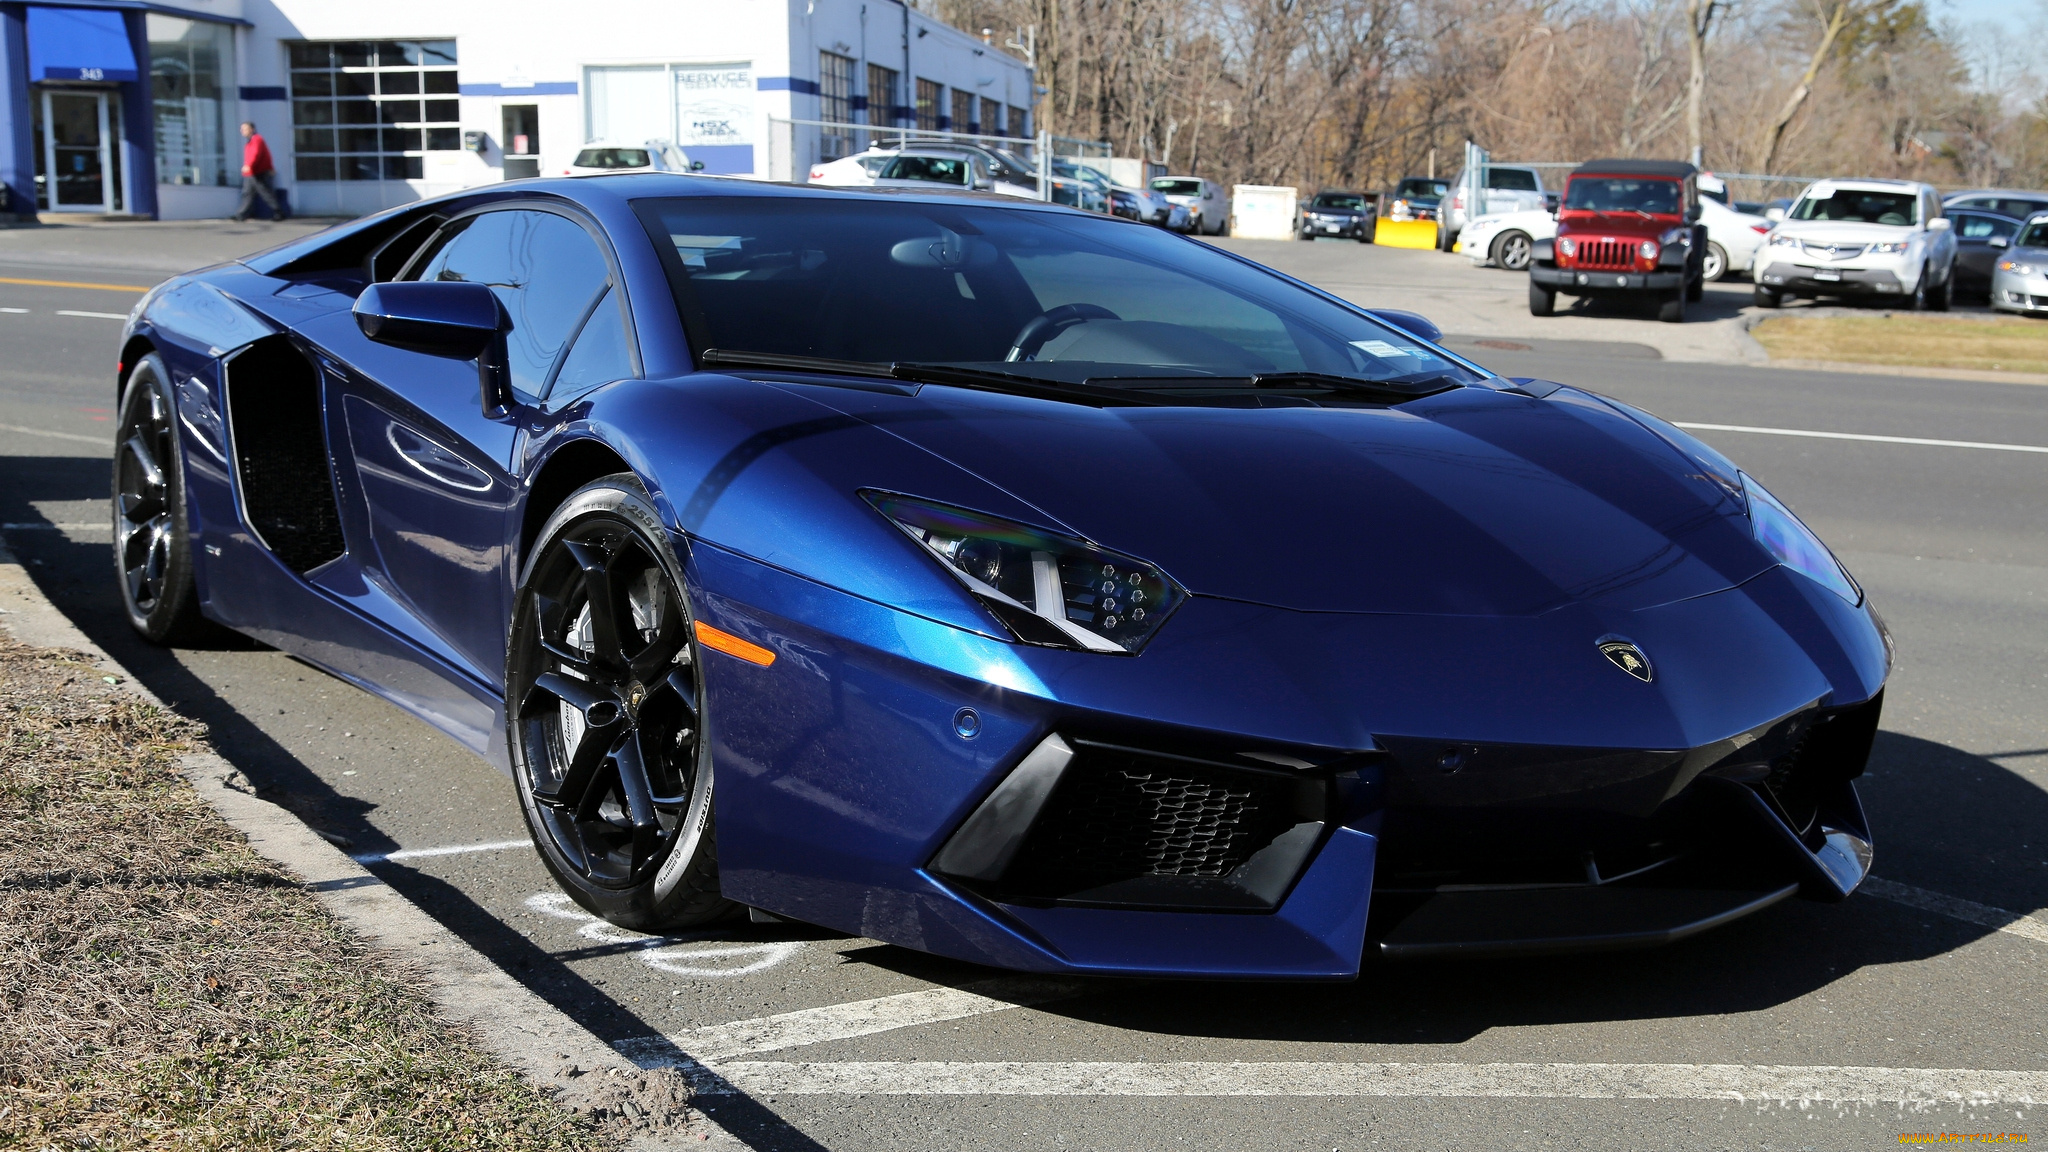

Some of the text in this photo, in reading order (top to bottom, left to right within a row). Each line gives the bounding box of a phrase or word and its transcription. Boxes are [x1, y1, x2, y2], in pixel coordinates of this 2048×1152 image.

[678, 71, 748, 82] SERVICE
[692, 120, 730, 129] NSX
[697, 786, 711, 833] OUTSIDE
